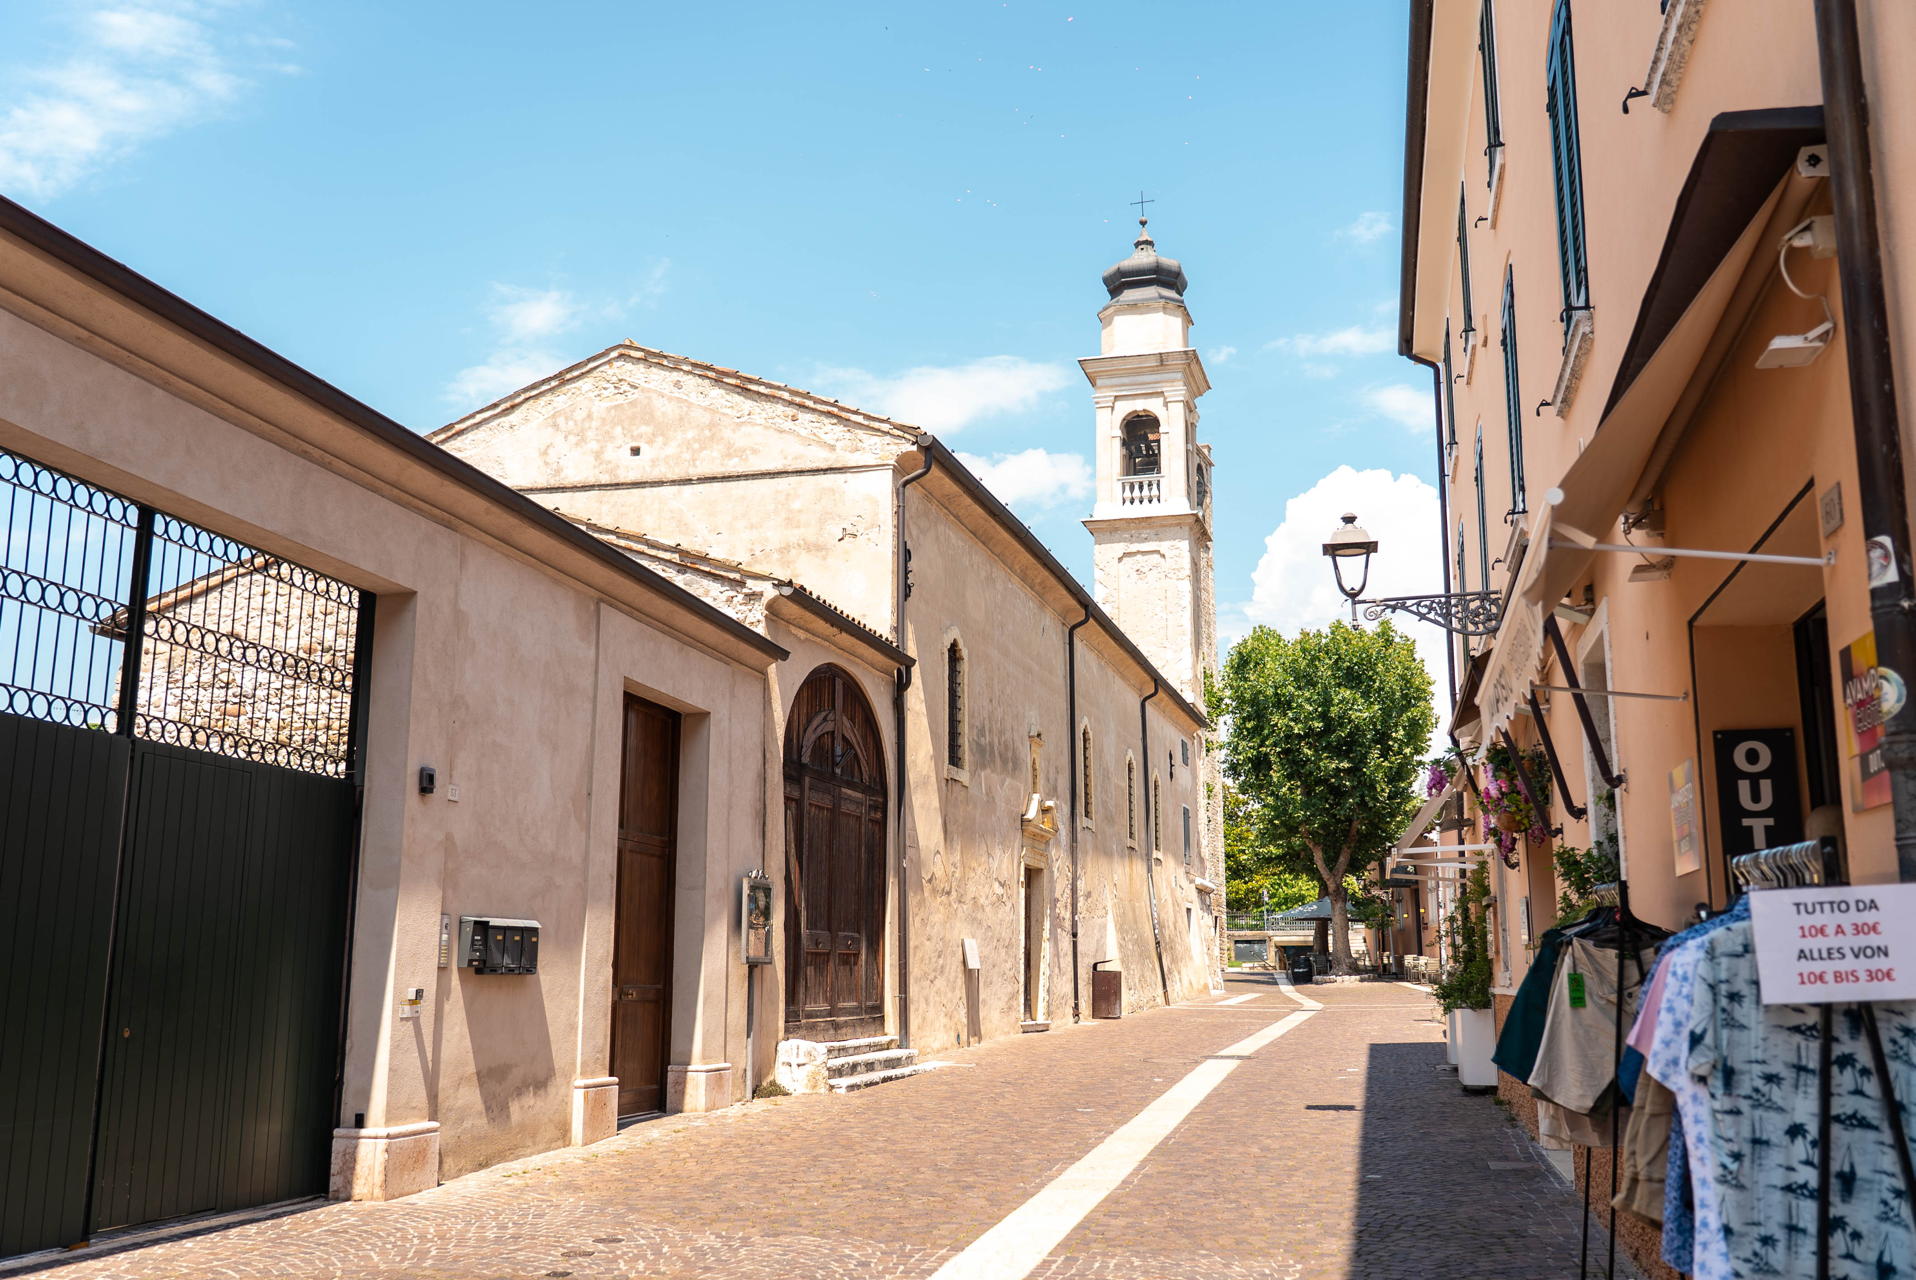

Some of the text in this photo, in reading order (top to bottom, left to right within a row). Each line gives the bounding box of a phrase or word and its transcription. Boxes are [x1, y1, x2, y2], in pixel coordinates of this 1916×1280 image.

[1845, 667, 1882, 708] AVAMP
[1733, 740, 1775, 850] OUT
[1792, 899, 1879, 915] TUTTO DA
[1798, 922, 1882, 938] 10€ A 30€
[1797, 945, 1889, 961] ALLES VON
[1798, 968, 1896, 985] 10€ BIS 30€
